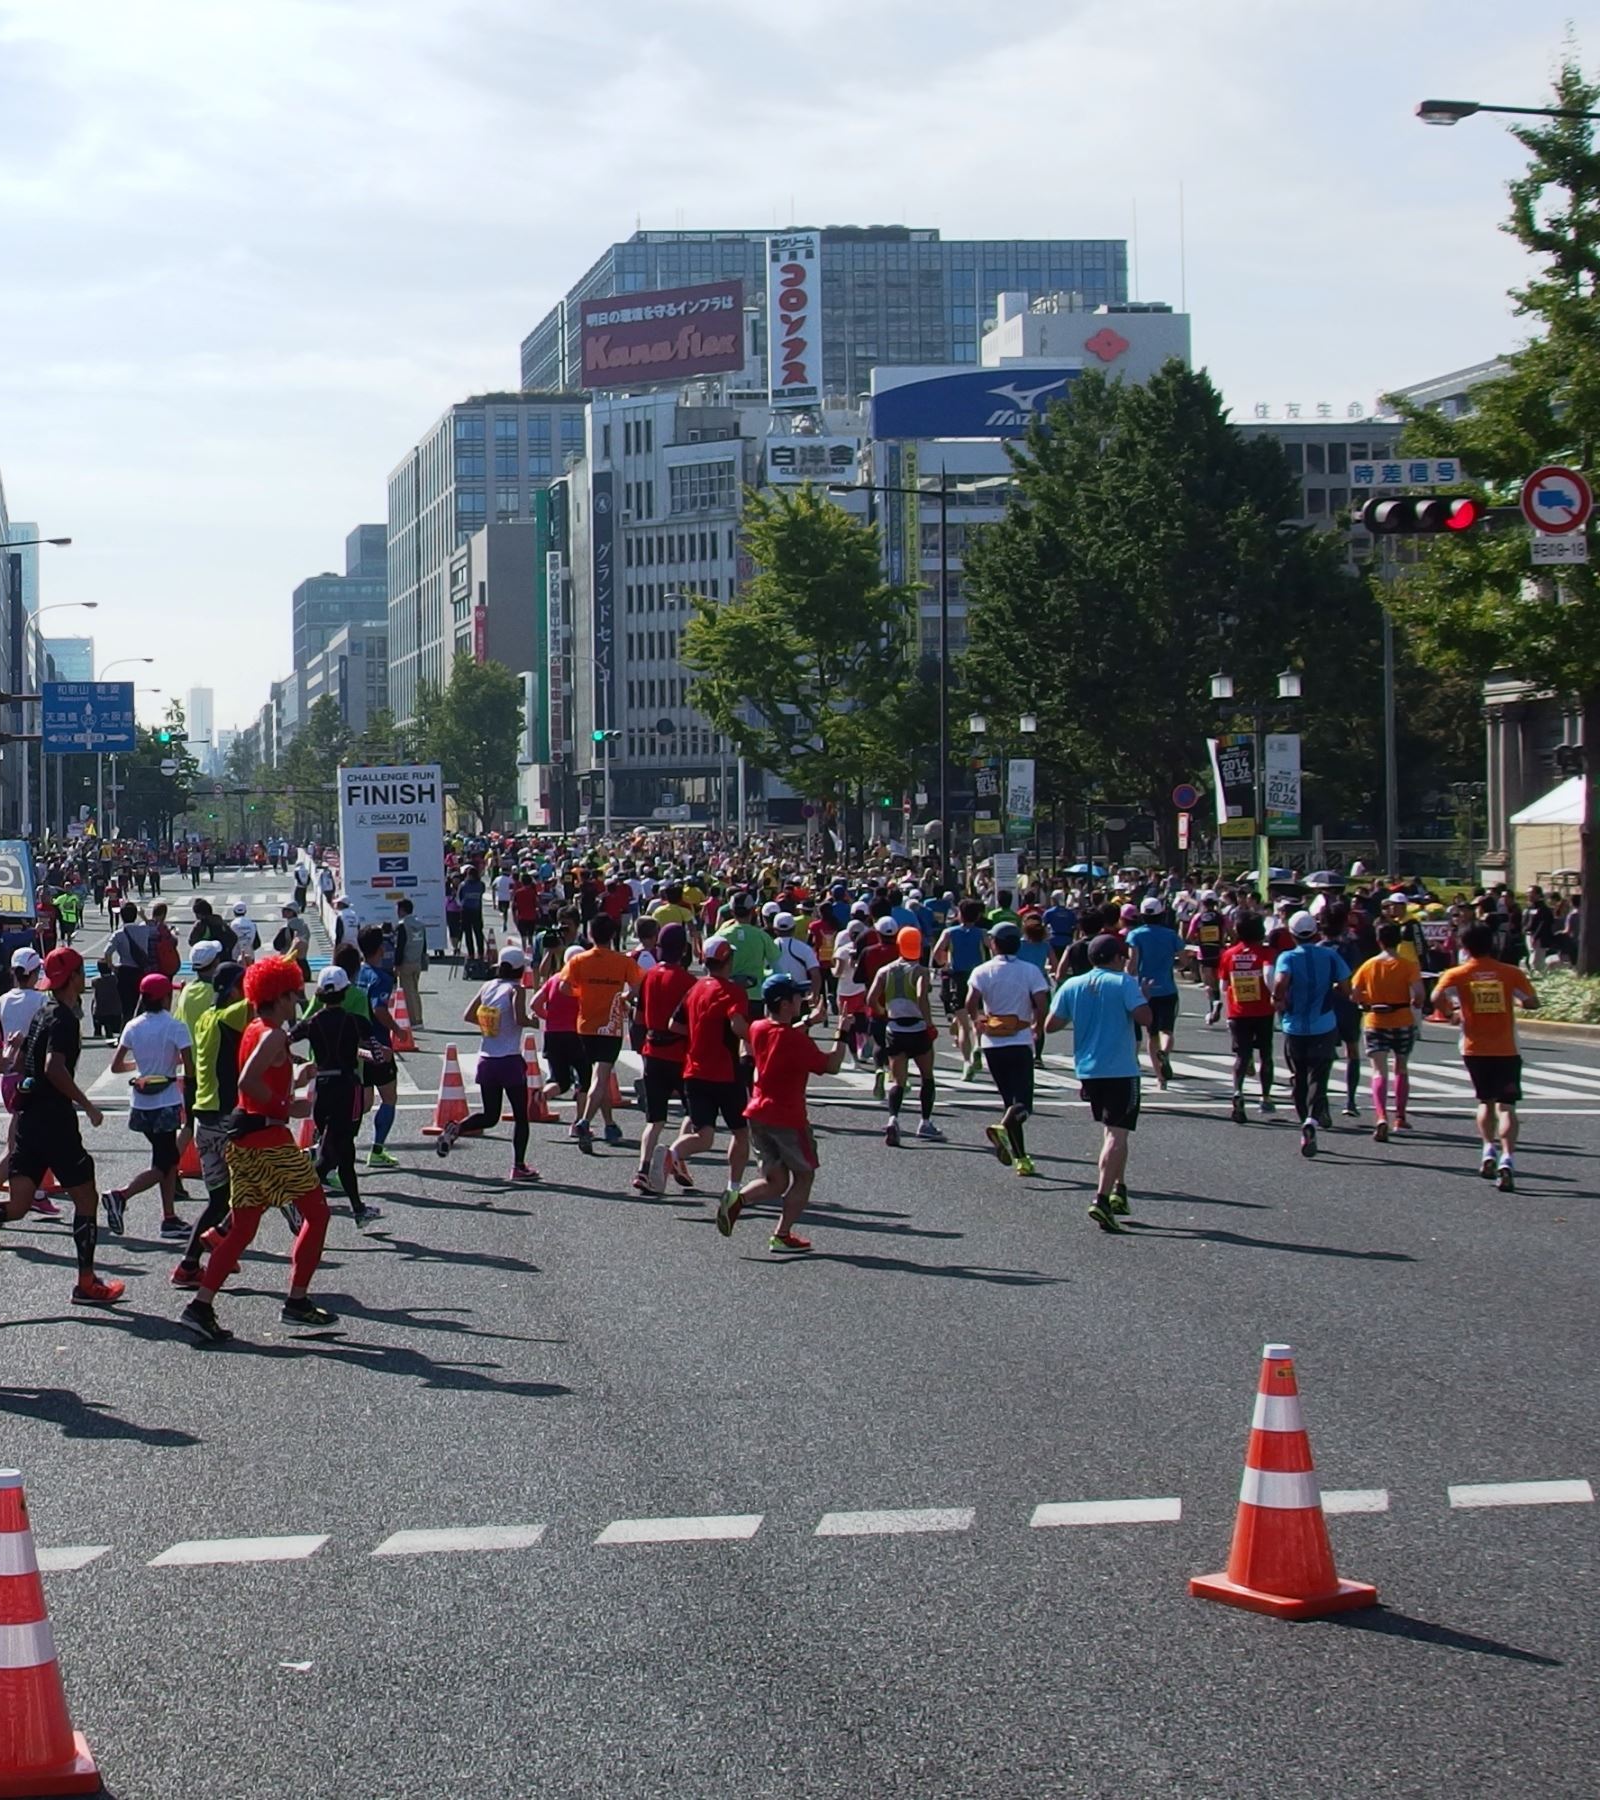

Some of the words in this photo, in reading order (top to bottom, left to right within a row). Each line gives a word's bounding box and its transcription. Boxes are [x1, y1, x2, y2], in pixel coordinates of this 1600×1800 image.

[1255, 402, 1364, 419] 住友生命
[780, 467, 812, 475] CLEAN
[814, 466, 846, 475] LIVING
[1354, 462, 1456, 484] 時差信号
[1222, 758, 1249, 770] 2014
[347, 772, 409, 782] CHALLENGE
[412, 772, 435, 780] RUN
[1223, 769, 1252, 781] 10.26
[1269, 781, 1297, 793] 2014
[348, 783, 435, 806] FINISH
[1268, 793, 1297, 805] 10.26
[399, 813, 427, 825] 2014
